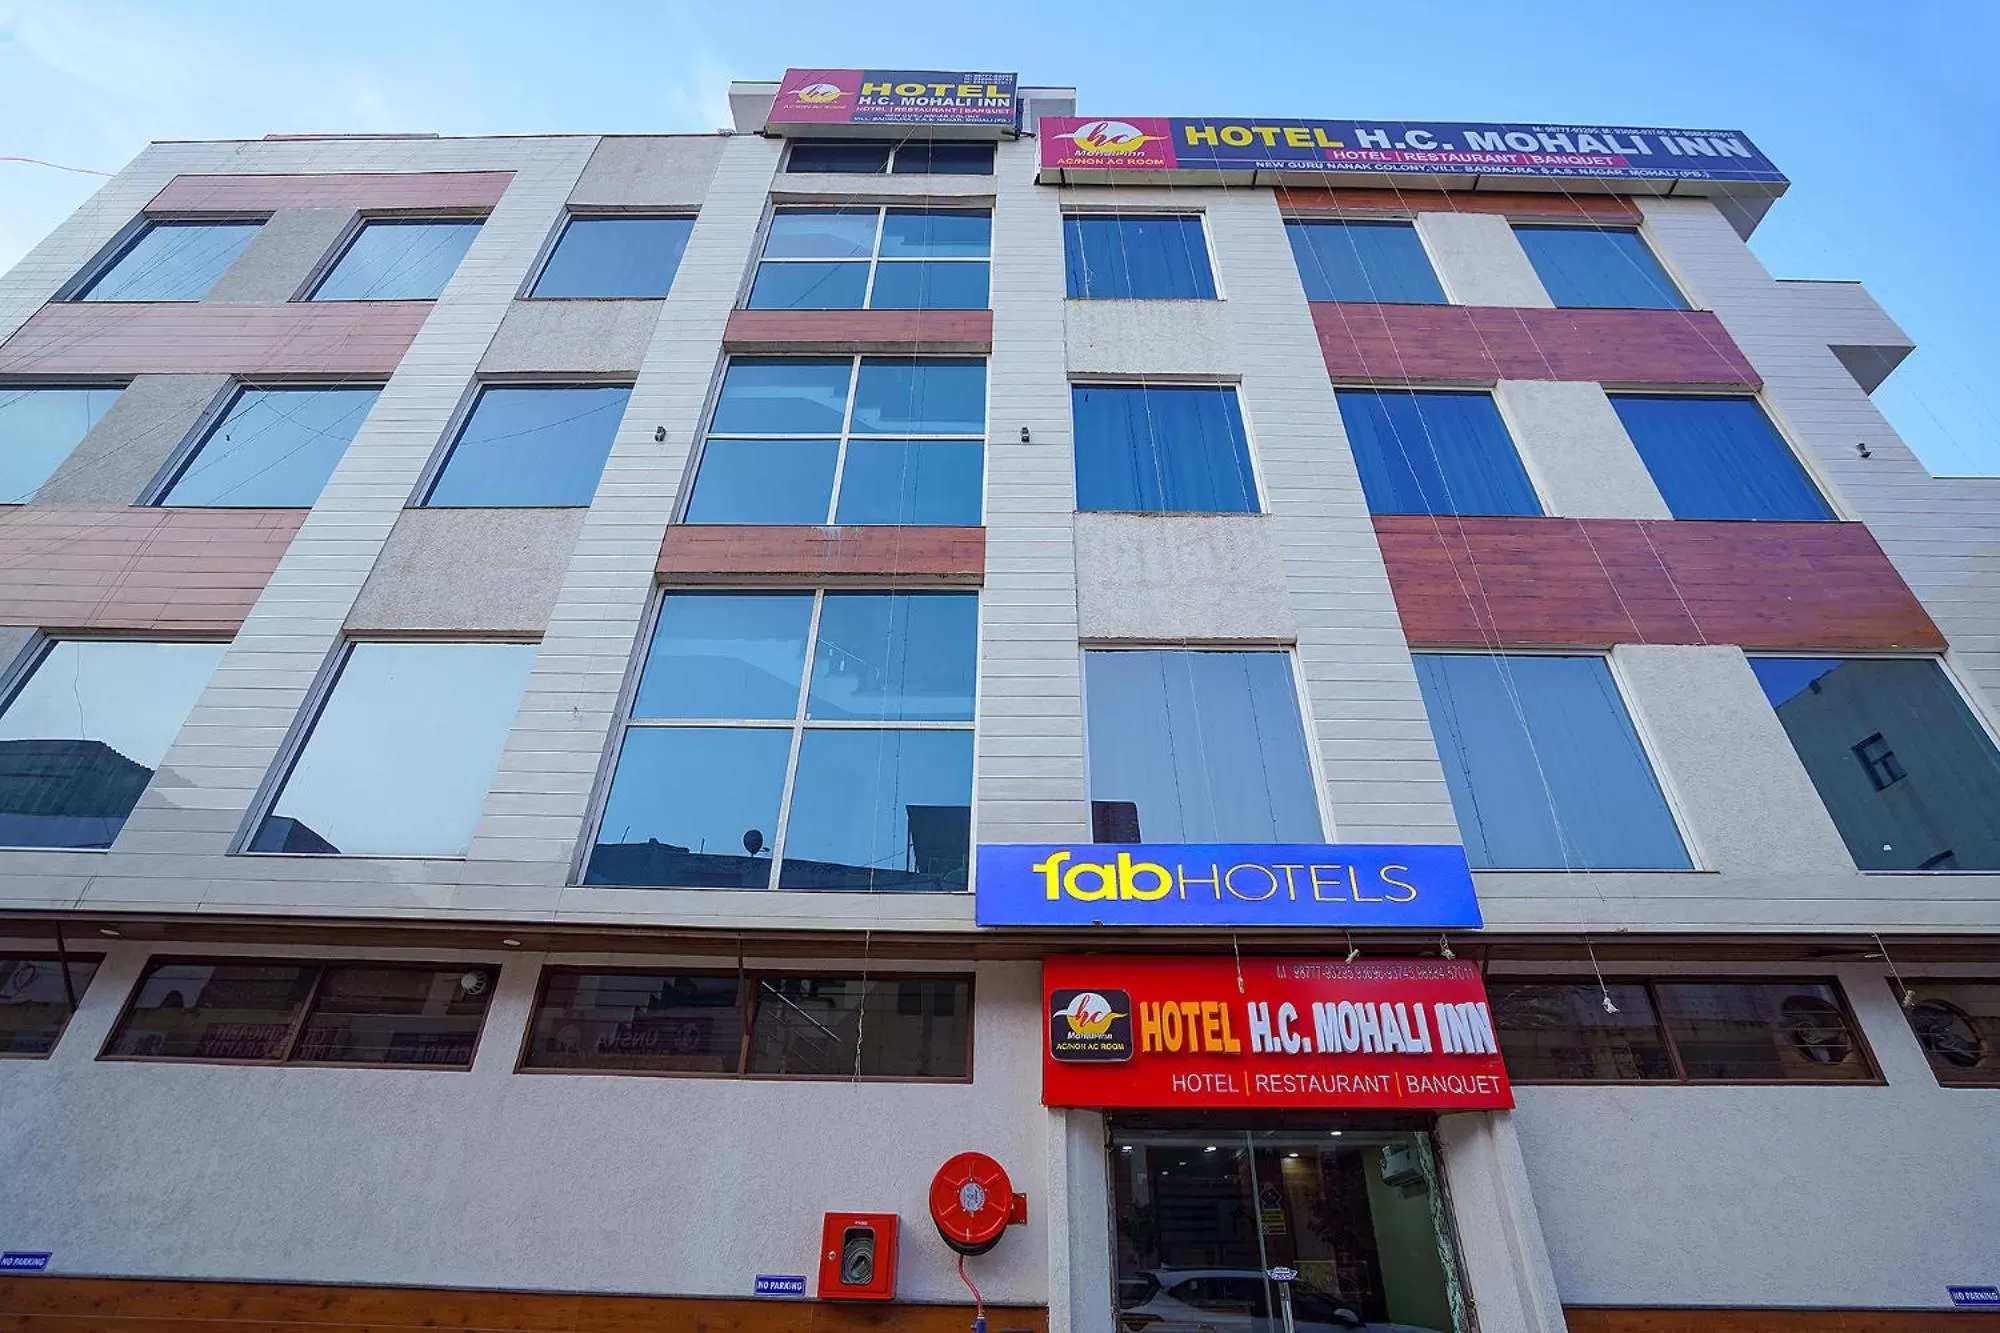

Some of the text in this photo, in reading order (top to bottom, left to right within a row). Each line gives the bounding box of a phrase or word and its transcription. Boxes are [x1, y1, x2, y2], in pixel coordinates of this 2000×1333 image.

[861, 82, 1010, 98] HOTEL
[858, 96, 1010, 107] H.C. MOHALI INN
[1185, 126, 1753, 158] HOTEL H.C. MOHALI INN
[1333, 151, 1614, 166] HOTEL RESTAURANT BANQUET
[1629, 169, 1678, 177] MOHALI
[1139, 1000, 1499, 1056] HOTEL H.C. MOHALI INN
[1172, 1073, 1501, 1095] HOTEL RESTAURANT BANQUET
[758, 1281, 803, 1291] NO PARKING
[1952, 1291, 1964, 1300] NO
